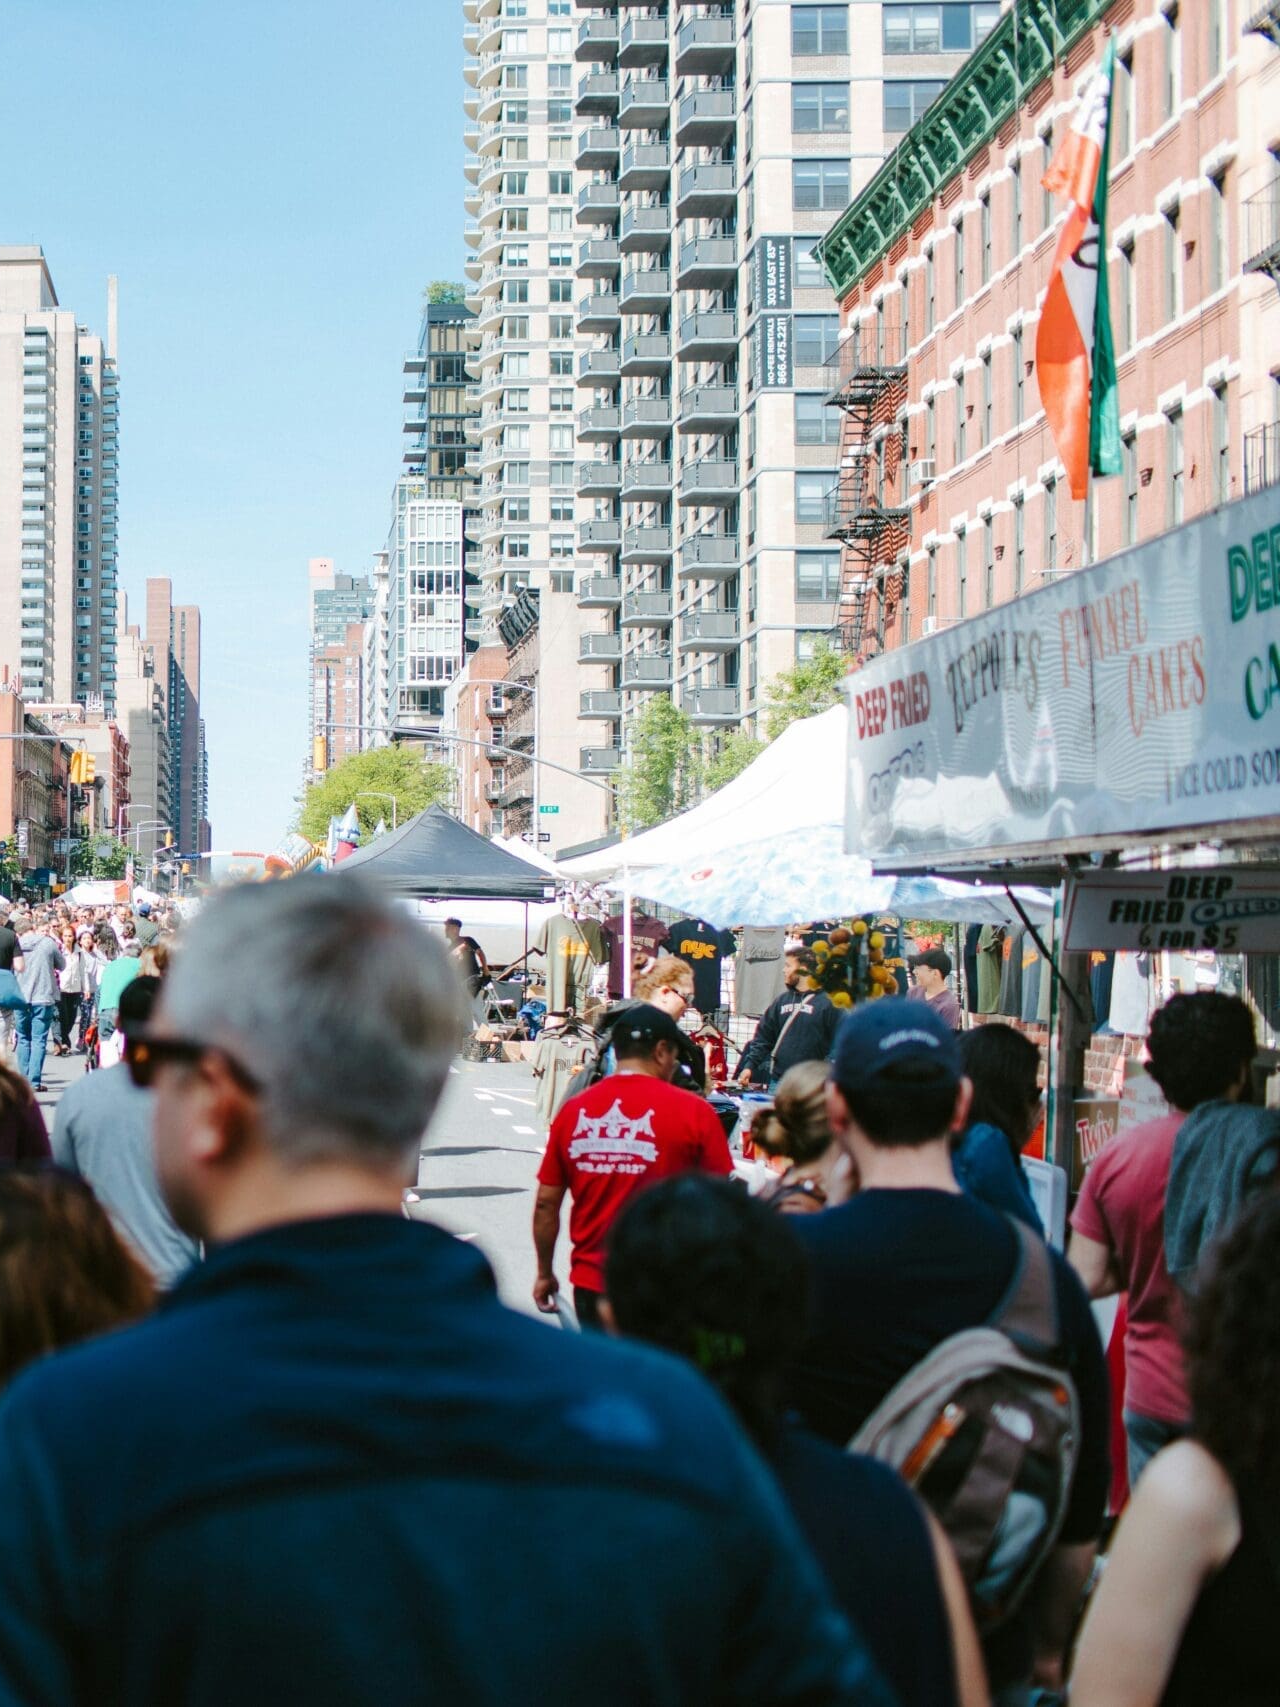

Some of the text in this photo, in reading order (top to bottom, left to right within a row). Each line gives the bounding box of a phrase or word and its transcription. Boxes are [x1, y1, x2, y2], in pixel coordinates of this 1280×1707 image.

[767, 260, 777, 283] EAST
[767, 287, 777, 307] 303
[767, 317, 775, 353] RENTALS
[1058, 578, 1148, 689] FUNNEL
[1127, 635, 1207, 739] CAKES
[854, 669, 932, 741] DEEP FRIED
[1203, 754, 1247, 793] COLD
[1167, 875, 1233, 900] DEEP
[1107, 900, 1186, 924] FRIED
[1158, 930, 1197, 948] FOR
